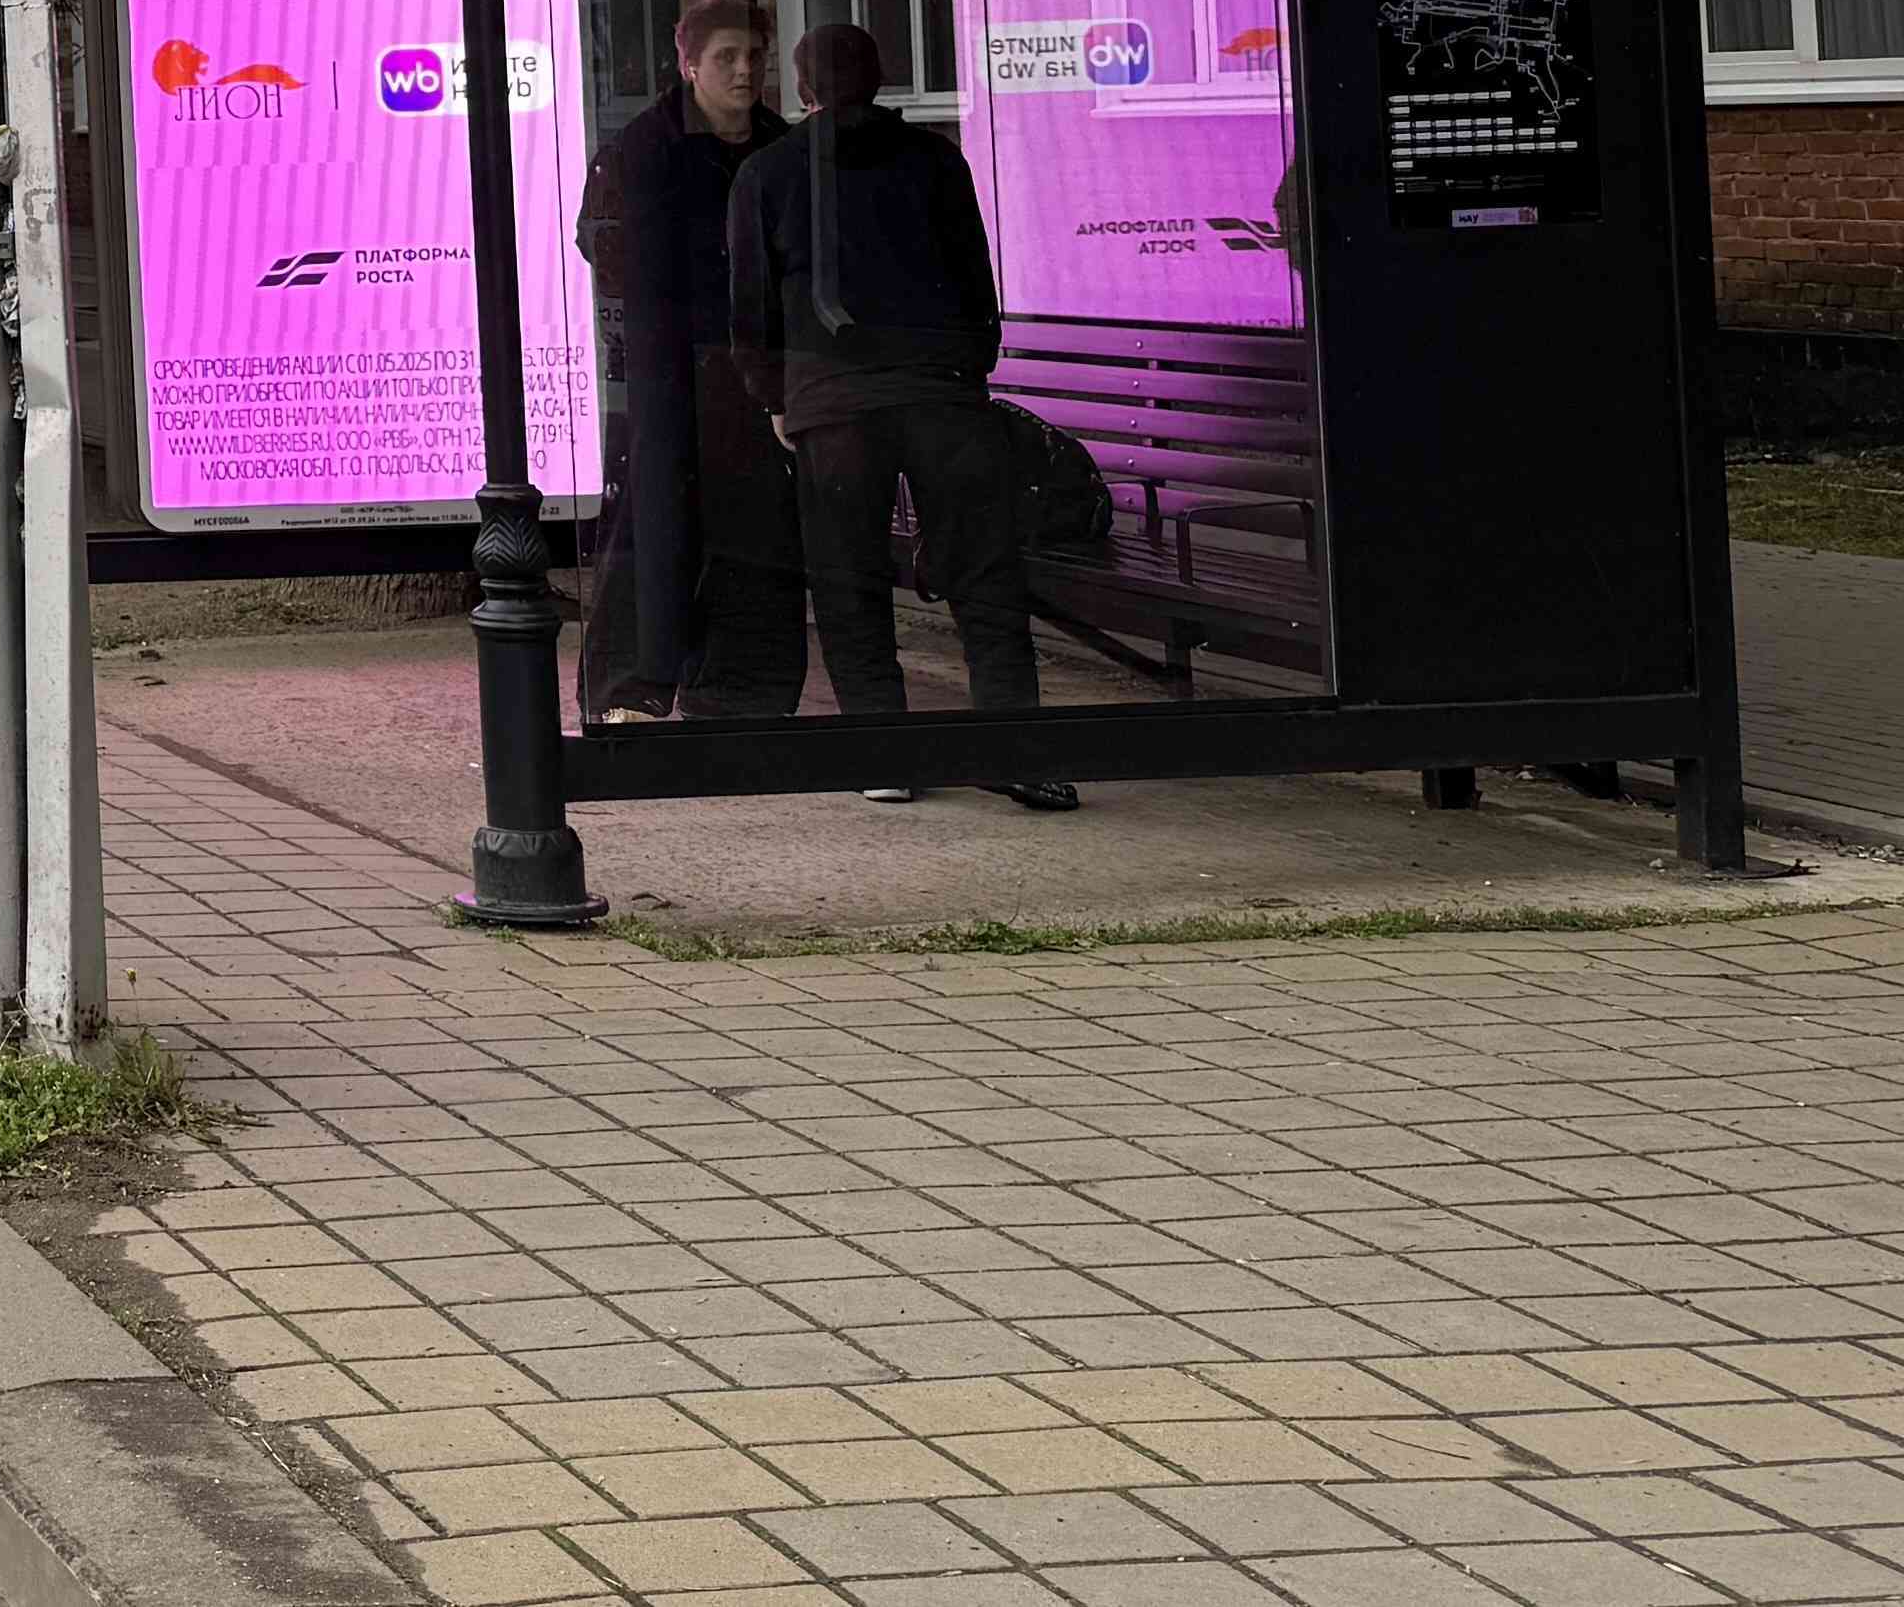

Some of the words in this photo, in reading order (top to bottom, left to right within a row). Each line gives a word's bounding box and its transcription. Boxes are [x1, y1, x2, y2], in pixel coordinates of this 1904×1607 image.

[383, 60, 440, 94] wb
[451, 56, 537, 76] ите
[175, 84, 284, 122] ЛИОН
[355, 247, 471, 264] ПЛАТФОРМА
[357, 269, 414, 284] РОСТА
[154, 360, 192, 380] СРОК
[194, 357, 290, 380] ПРОВЕДЕНИЯ
[293, 355, 343, 377] АКЦИИ
[346, 353, 356, 374] С
[358, 351, 432, 373] 01.05.2025
[435, 350, 456, 371] ПО
[153, 384, 214, 405] МОЖНО
[216, 381, 311, 404] ПРИОБРЕСТИ
[313, 380, 336, 400] ПО
[338, 378, 389, 399] АКЦИИ
[391, 377, 448, 397] ТОЛЬКО
[155, 410, 200, 431] ТОВАР
[203, 408, 271, 429] ИМЕЕТСЯ
[274, 408, 284, 426] В
[365, 402, 437, 423] НАЛИЧИЕ
[337, 430, 371, 451] ООО
[424, 426, 462, 447] ОГРН
[201, 458, 299, 480] МОСКОВСКАЯ
